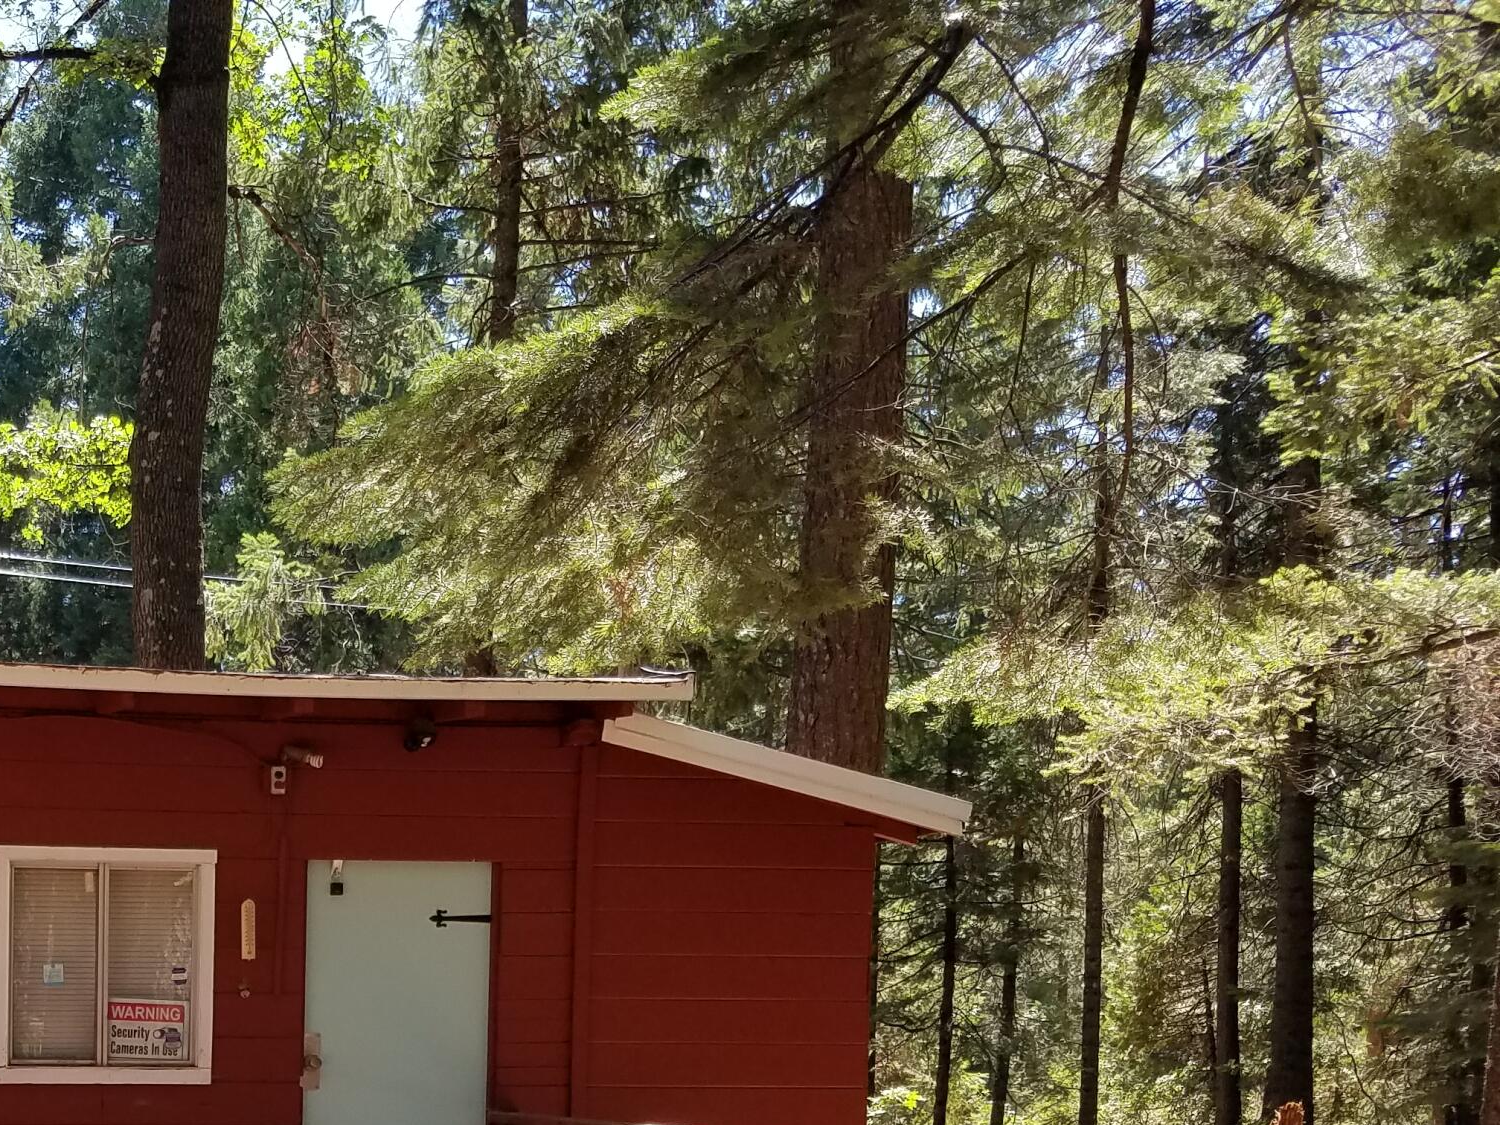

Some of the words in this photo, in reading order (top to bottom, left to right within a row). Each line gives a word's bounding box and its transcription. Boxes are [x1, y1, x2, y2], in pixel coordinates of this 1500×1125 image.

[111, 1005, 181, 1021] WARNING
[111, 1025, 150, 1041] Security
[110, 1041, 148, 1055] Cameras
[152, 1043, 159, 1056] In
